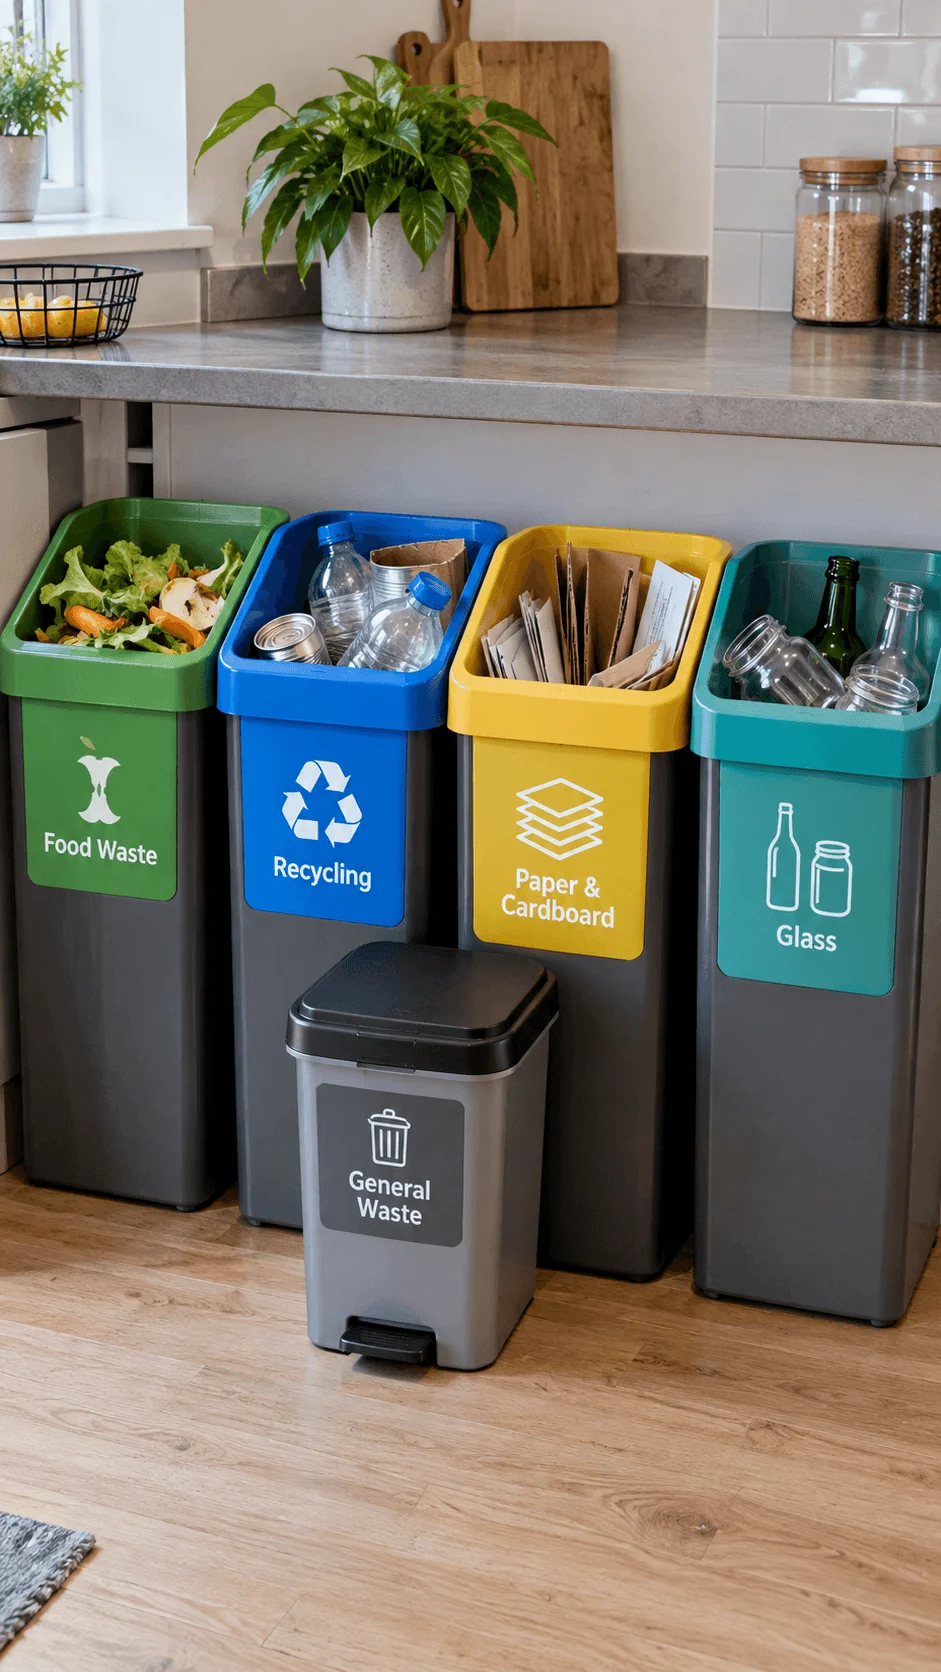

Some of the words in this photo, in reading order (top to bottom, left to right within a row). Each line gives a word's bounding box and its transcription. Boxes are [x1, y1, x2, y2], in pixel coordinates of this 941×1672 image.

[44, 831, 92, 858] Food
[96, 838, 158, 866] Waste
[273, 855, 373, 893] Recycling
[515, 867, 579, 897] Paper
[583, 875, 601, 899] &
[500, 893, 615, 929] Cardboard
[776, 924, 837, 952] Glass
[348, 1170, 431, 1201] General
[356, 1196, 423, 1226] Waste
